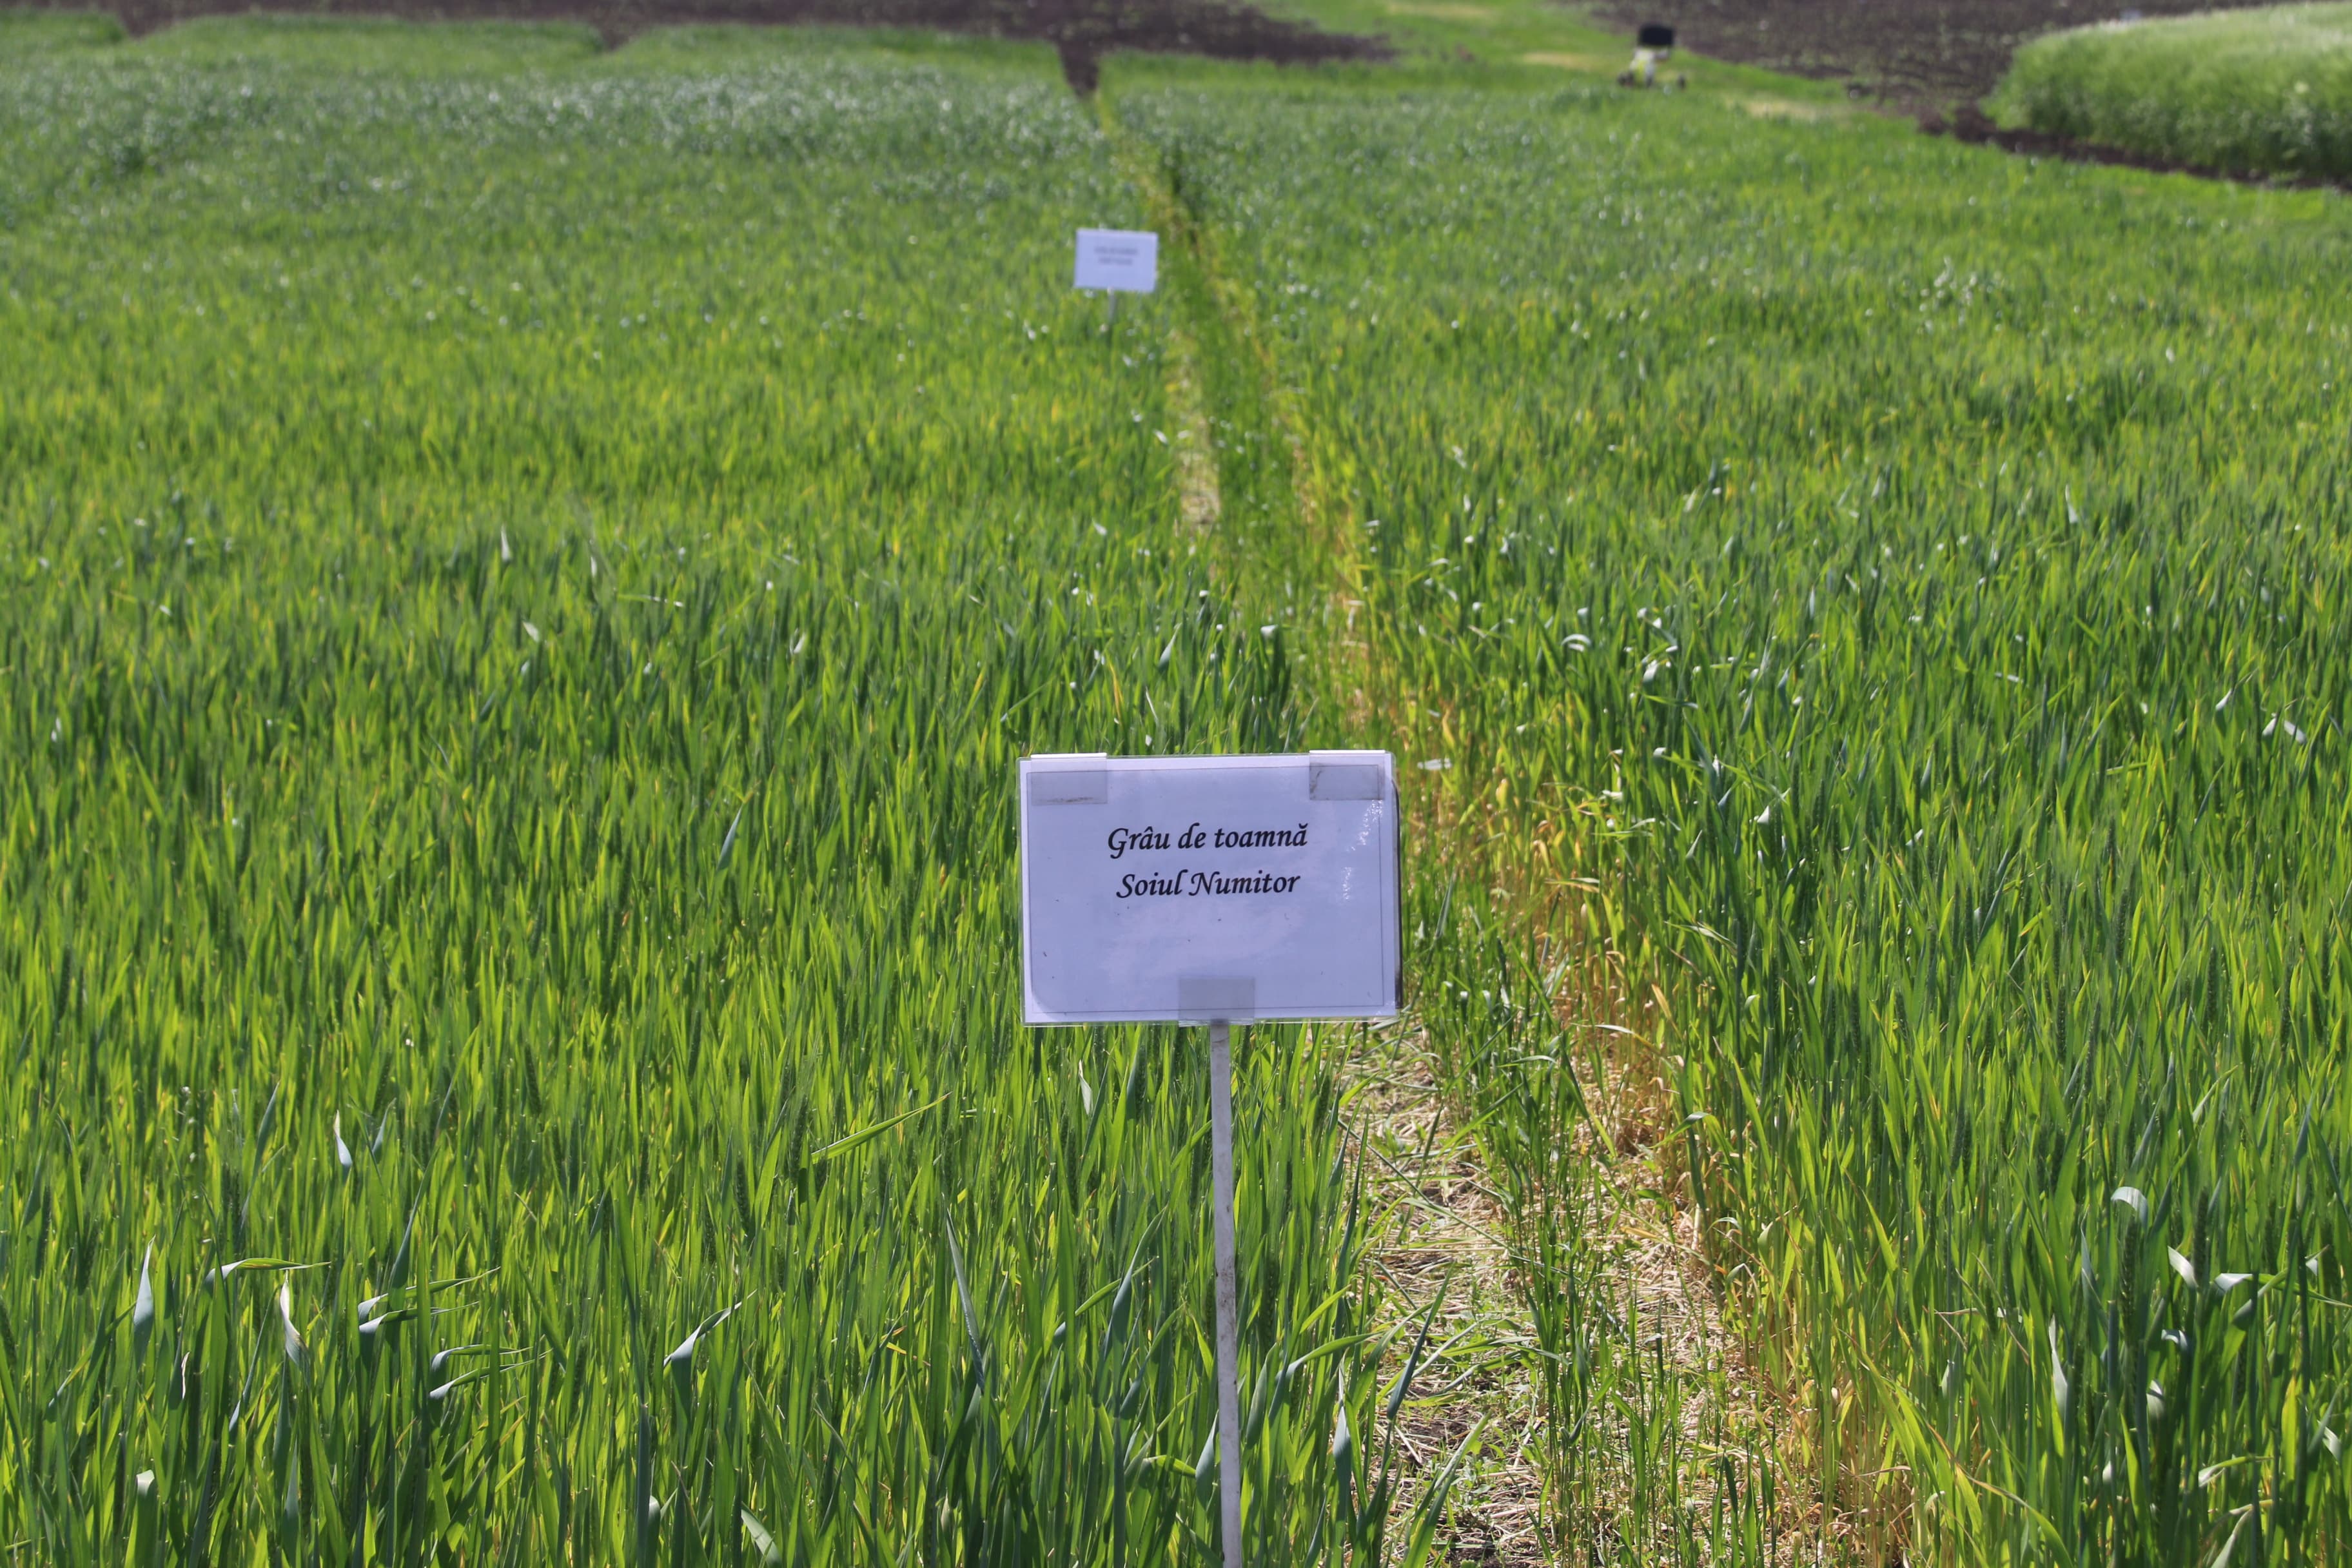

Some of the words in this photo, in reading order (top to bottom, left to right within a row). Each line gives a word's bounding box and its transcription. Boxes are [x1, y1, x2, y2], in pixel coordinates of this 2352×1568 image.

[1108, 826, 1170, 859] Grâu
[1178, 823, 1206, 848] de
[1214, 823, 1308, 848] toamnă
[1116, 869, 1188, 898] Soiul
[1188, 870, 1300, 896] Numitor
